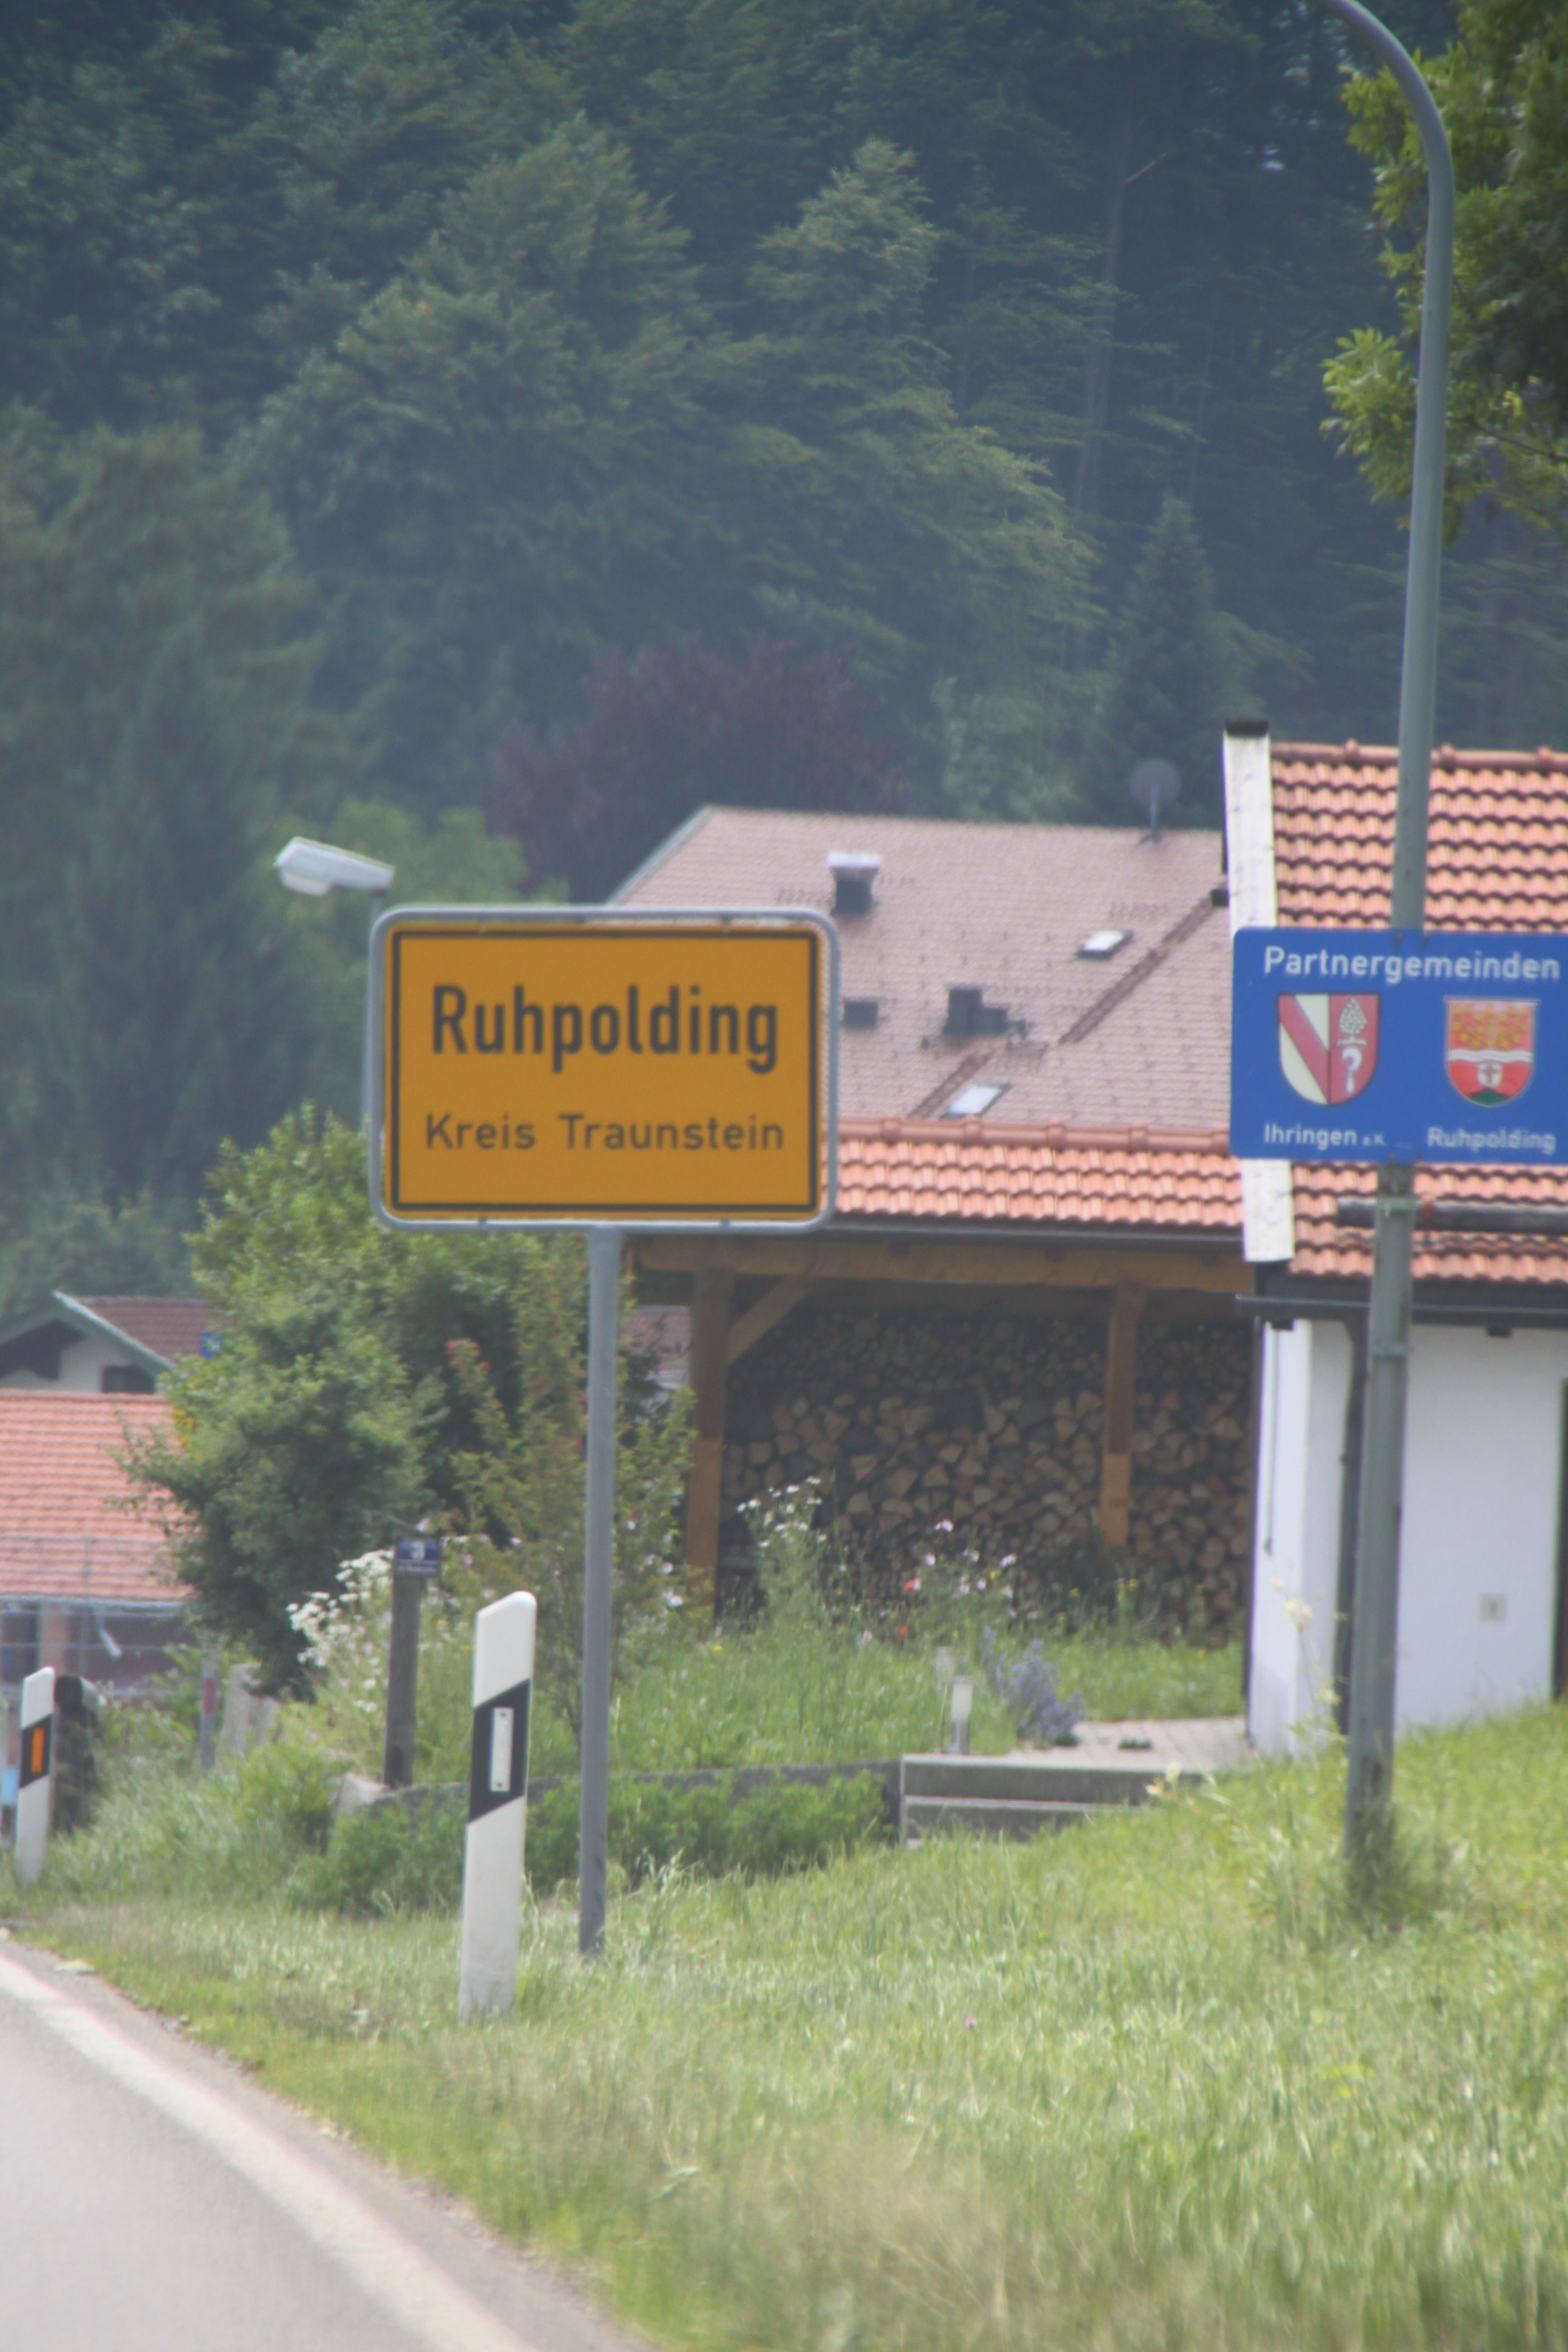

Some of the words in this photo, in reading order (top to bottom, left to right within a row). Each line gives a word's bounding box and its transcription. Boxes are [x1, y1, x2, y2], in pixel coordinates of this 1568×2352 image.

[1264, 945, 1561, 984] Partnergemeinden
[433, 984, 778, 1074] Ruhpolding
[425, 1113, 536, 1150] Kreis
[558, 1113, 784, 1151] Traunstein
[1264, 1123, 1357, 1151] Ihringen
[1427, 1126, 1557, 1155] Ruhpolding
